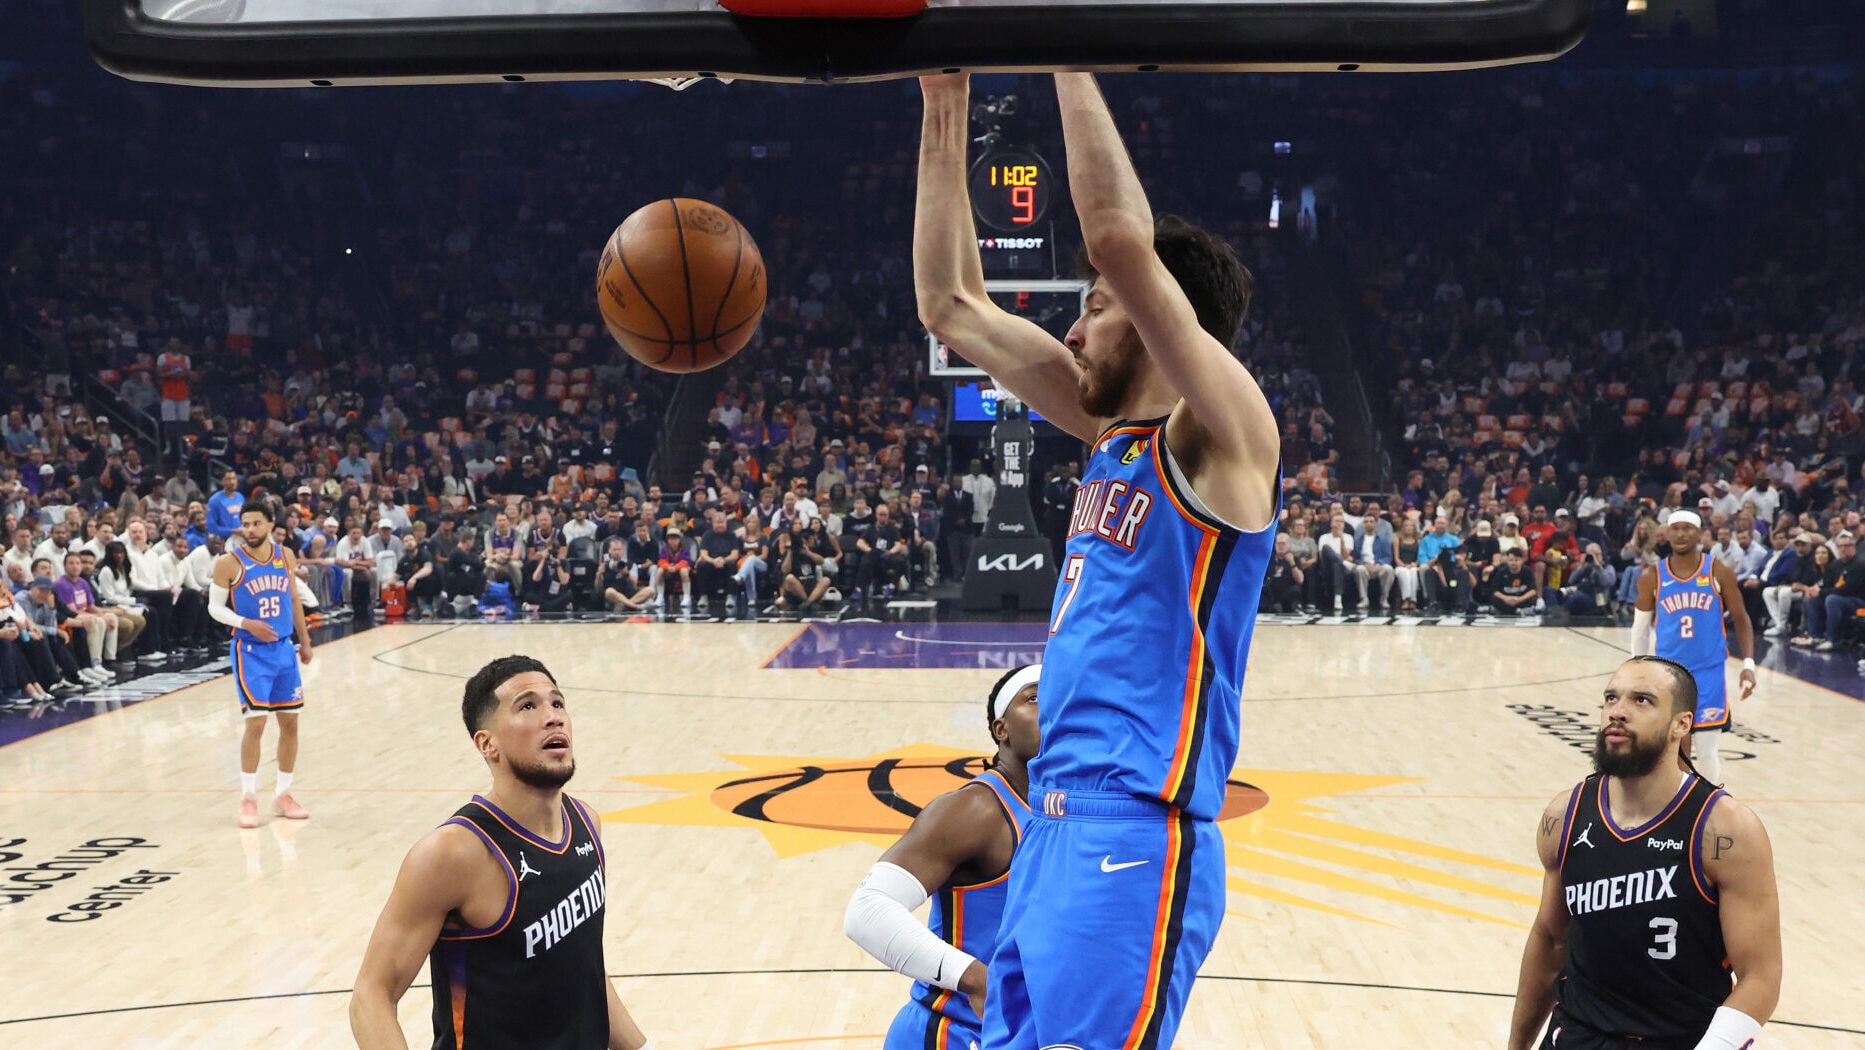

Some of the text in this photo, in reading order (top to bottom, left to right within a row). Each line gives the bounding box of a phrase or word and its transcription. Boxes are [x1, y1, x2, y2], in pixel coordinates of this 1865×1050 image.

[990, 166, 1038, 186] 11:02
[1011, 186, 1034, 223] 9
[995, 238, 1043, 249] TISSOT
[1003, 441, 1020, 456] GET
[1004, 456, 1020, 470] THE
[244, 574, 290, 596] THUNDER
[1049, 554, 1086, 635] 7
[258, 595, 281, 619] 25
[1660, 591, 1714, 614] THUNDER
[1680, 615, 1694, 638] 2
[1044, 791, 1067, 817] OKC
[1647, 837, 1684, 851] PayPal
[1711, 836, 1734, 860] P
[46, 869, 180, 923] center
[1565, 865, 1678, 916] PHOENIX
[523, 865, 605, 958] PHOENIX
[1648, 917, 1678, 960] 3
